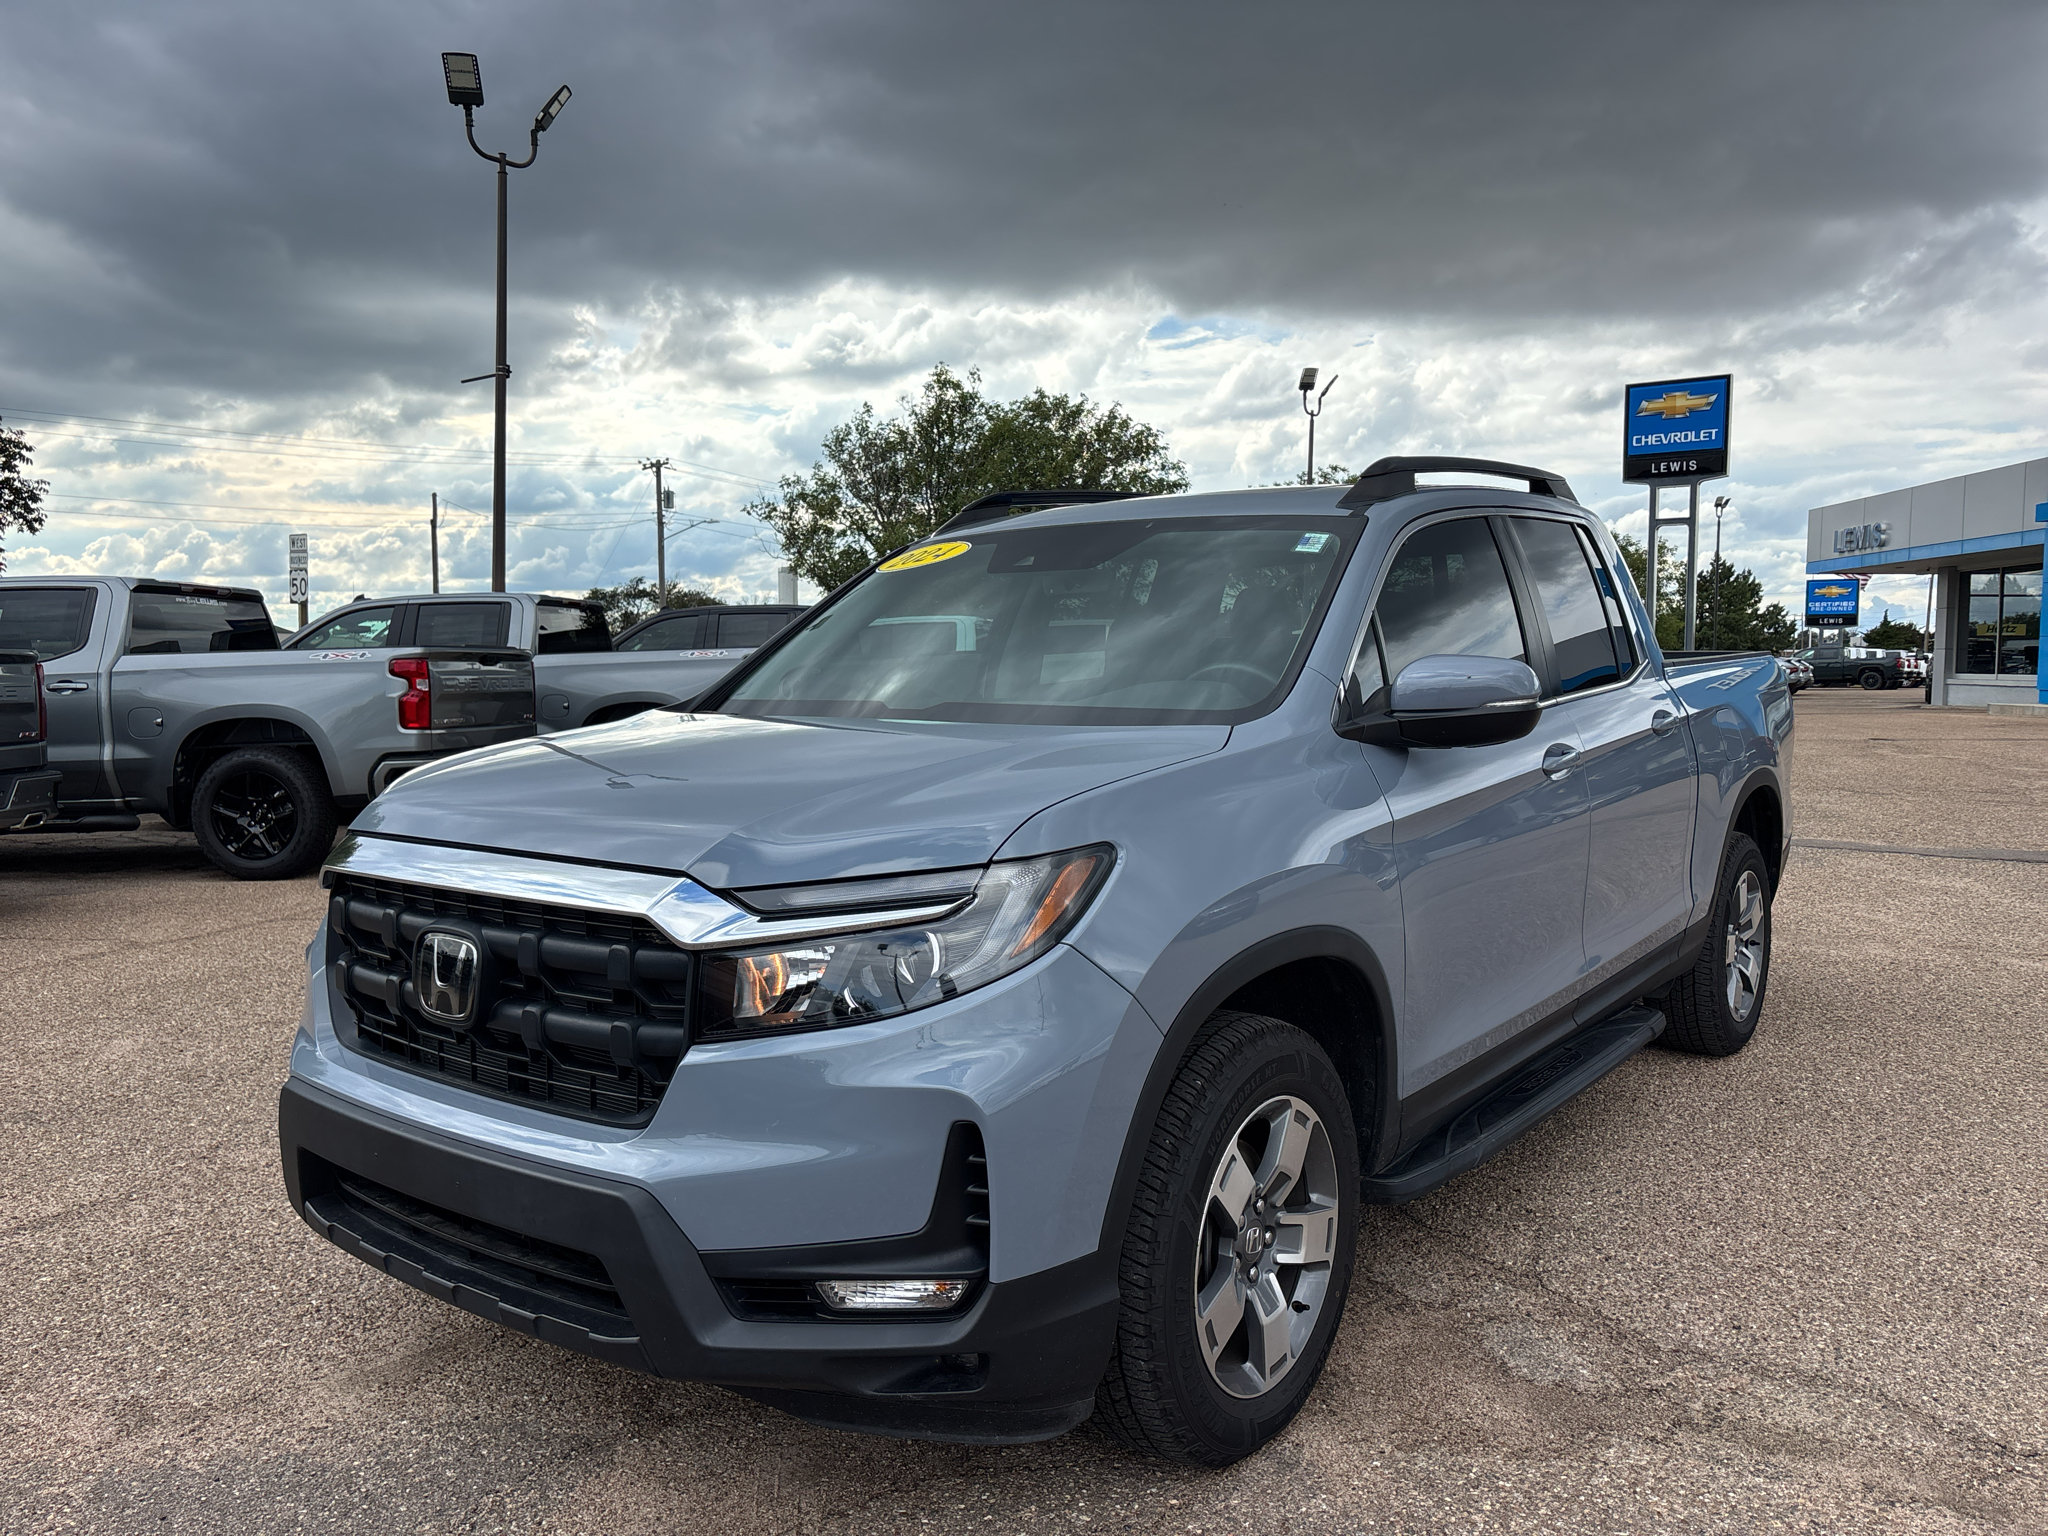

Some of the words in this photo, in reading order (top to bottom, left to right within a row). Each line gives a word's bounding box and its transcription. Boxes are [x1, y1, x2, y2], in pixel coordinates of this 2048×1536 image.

[1632, 428, 1719, 447] CHEVROLET
[1651, 459, 1698, 474] LEWIS
[291, 537, 306, 549] WEST
[1833, 522, 1888, 553] LEWIS
[884, 544, 963, 570] 2024
[291, 577, 307, 597] 50
[1986, 624, 2017, 633] Hrtz
[1207, 1072, 1263, 1156] WORKHORSE
[1264, 1061, 1278, 1079] HT
